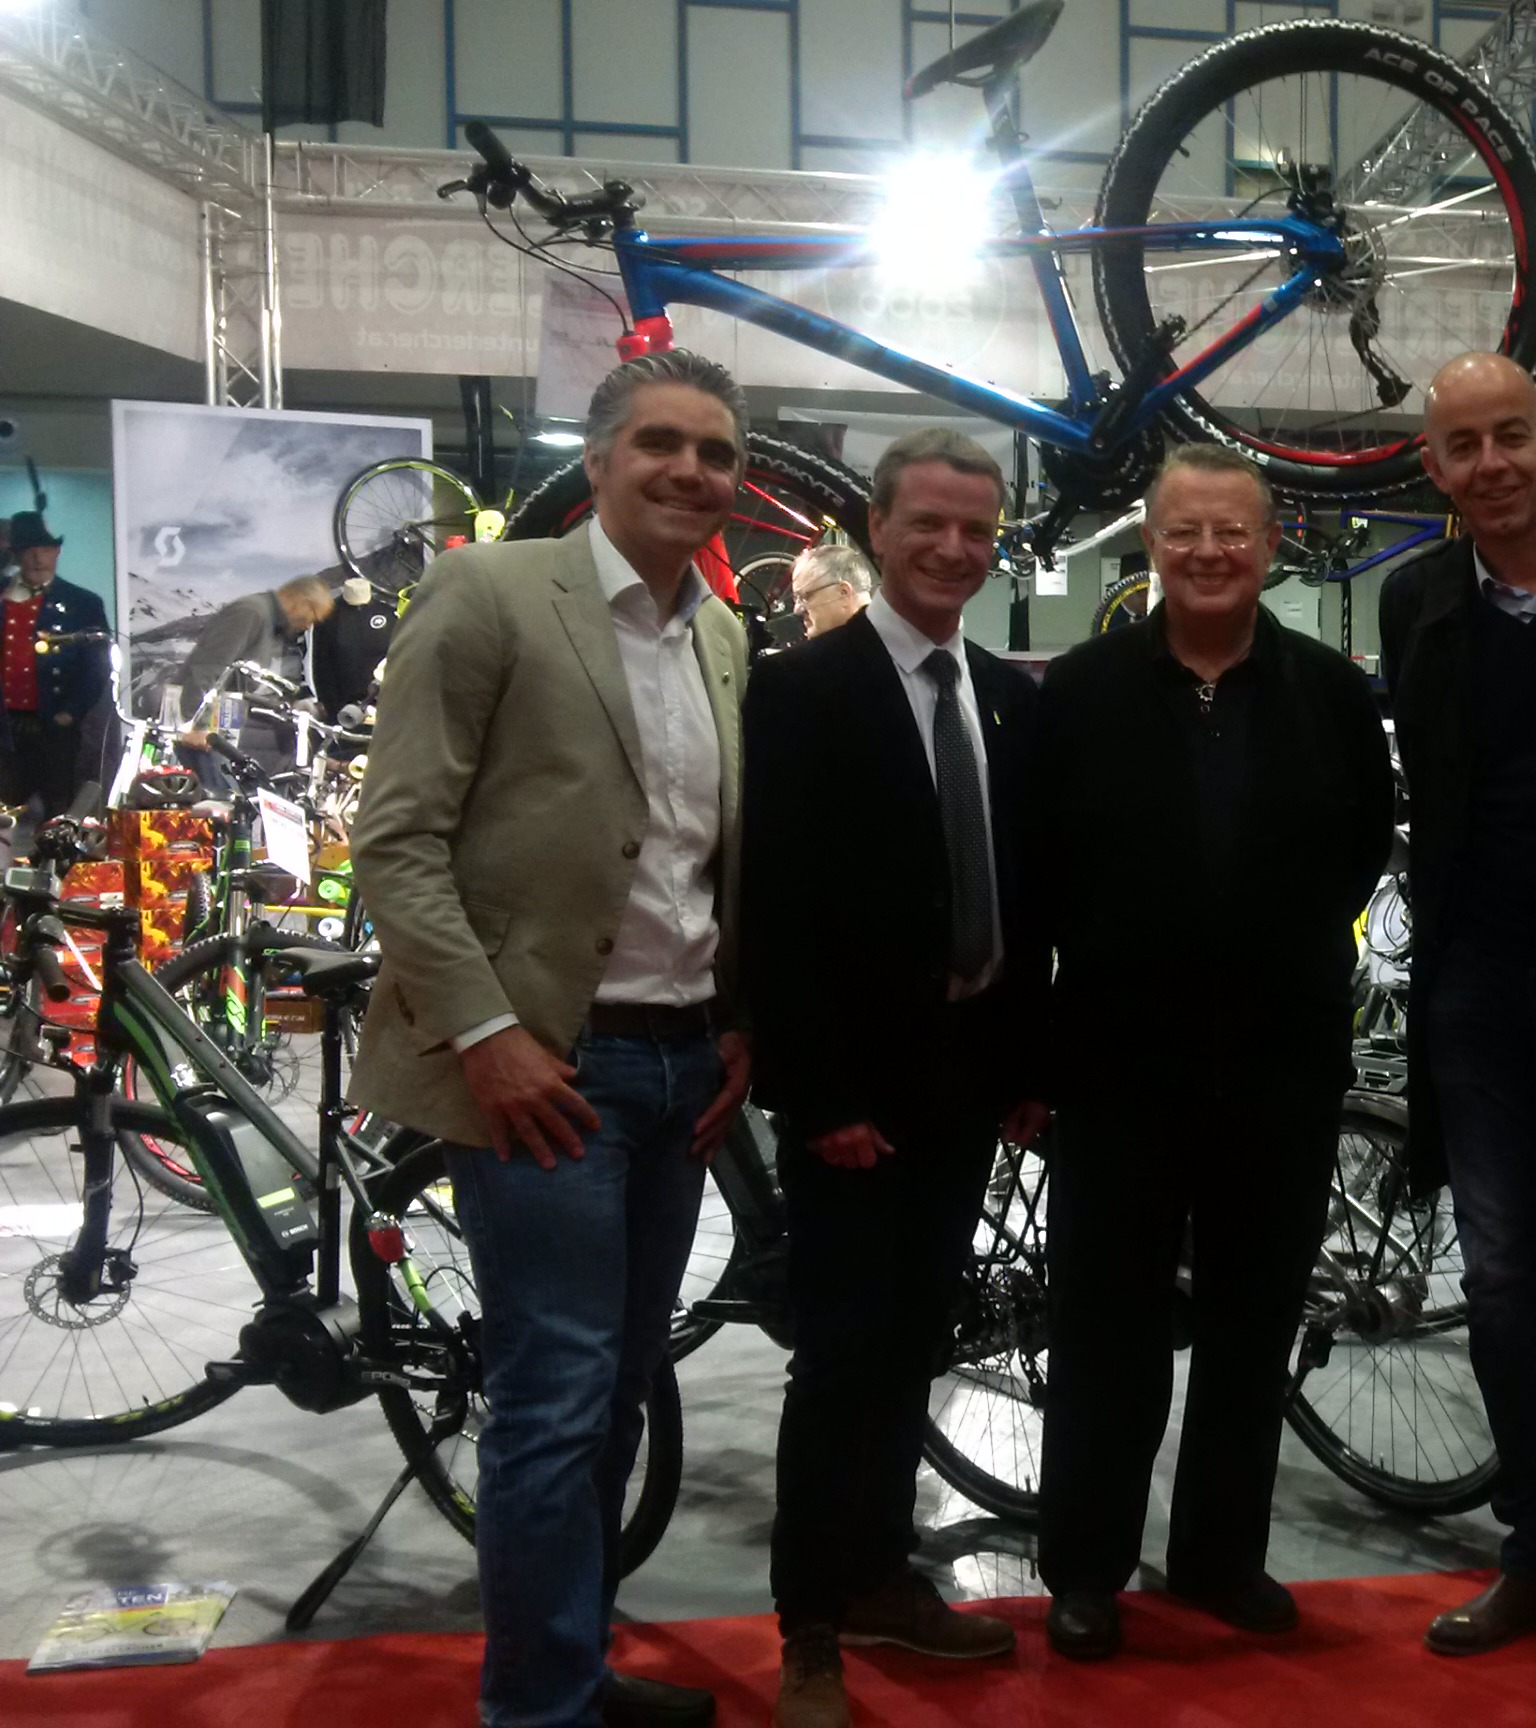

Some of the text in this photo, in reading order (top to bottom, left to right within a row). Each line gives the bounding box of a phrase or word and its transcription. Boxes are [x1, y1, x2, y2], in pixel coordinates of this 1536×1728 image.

[1364, 48, 1513, 162] ACE OF PACE
